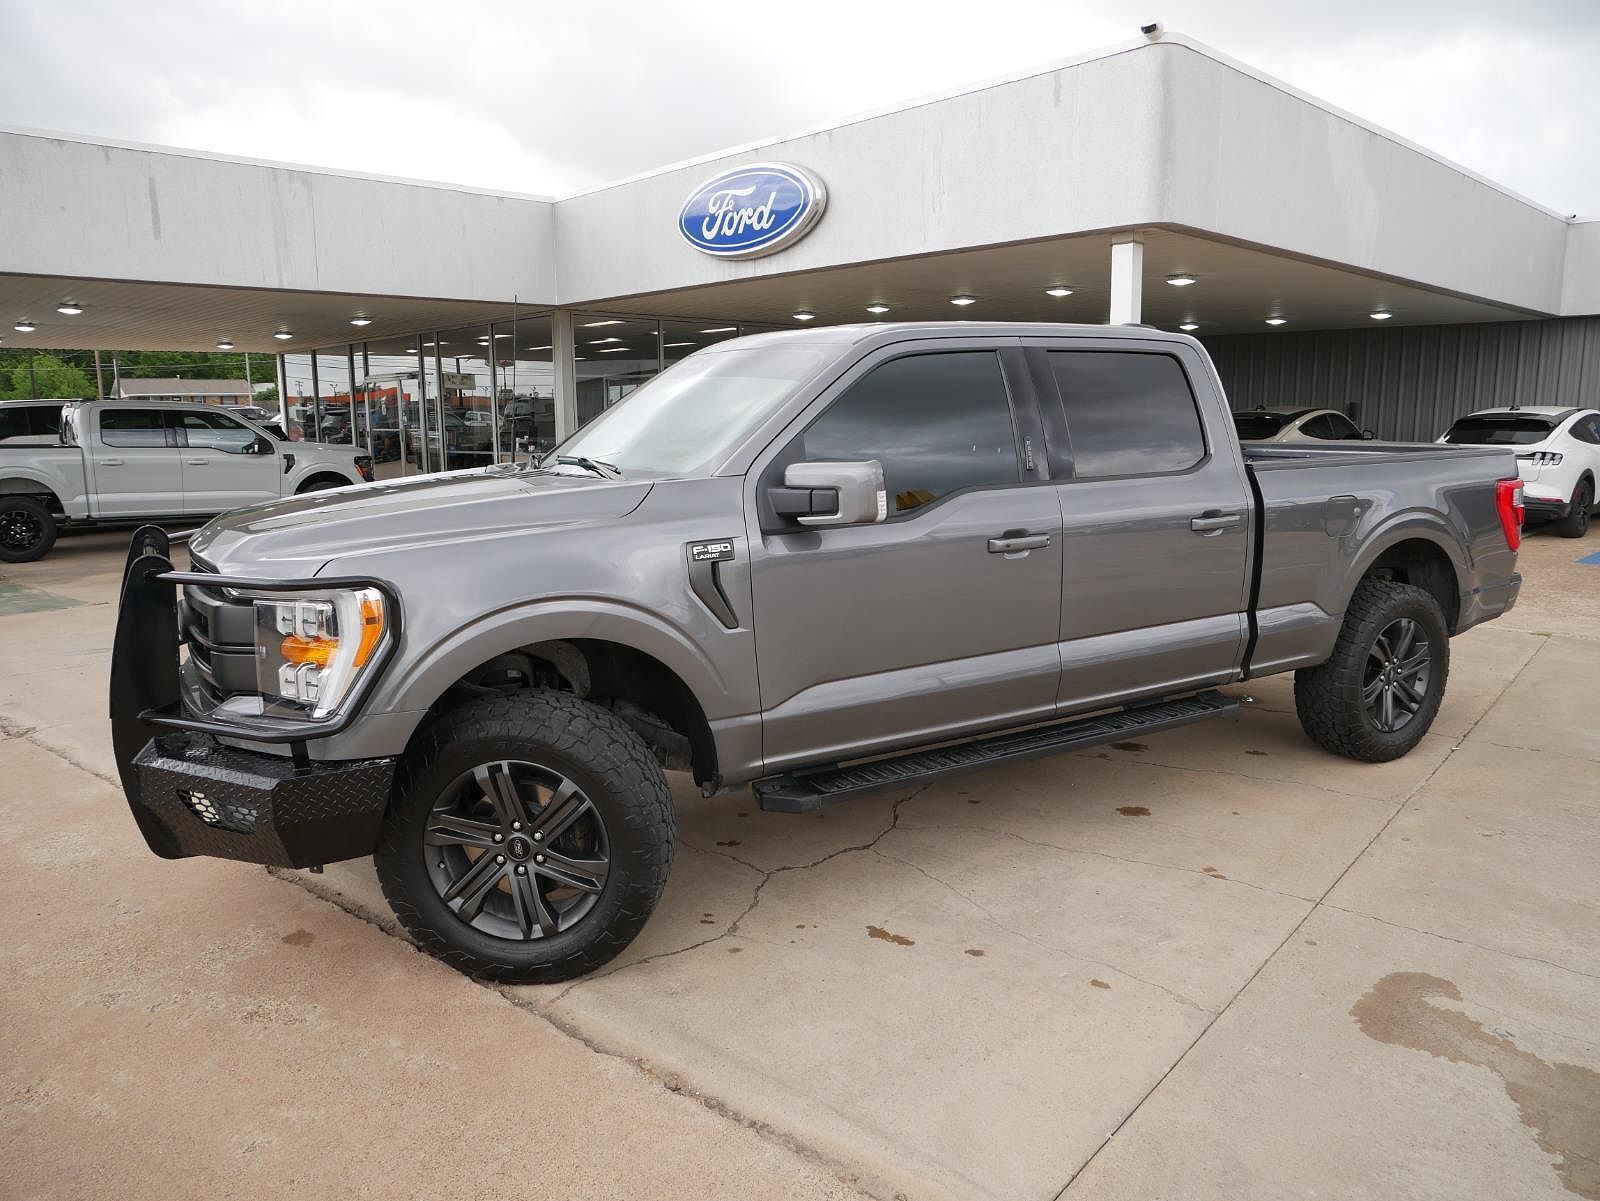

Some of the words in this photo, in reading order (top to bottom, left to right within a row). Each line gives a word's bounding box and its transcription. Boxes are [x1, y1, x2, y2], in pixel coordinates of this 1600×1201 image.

[701, 185, 777, 240] Ford
[692, 543, 732, 555] F-150
[695, 552, 720, 560] LARIAT
